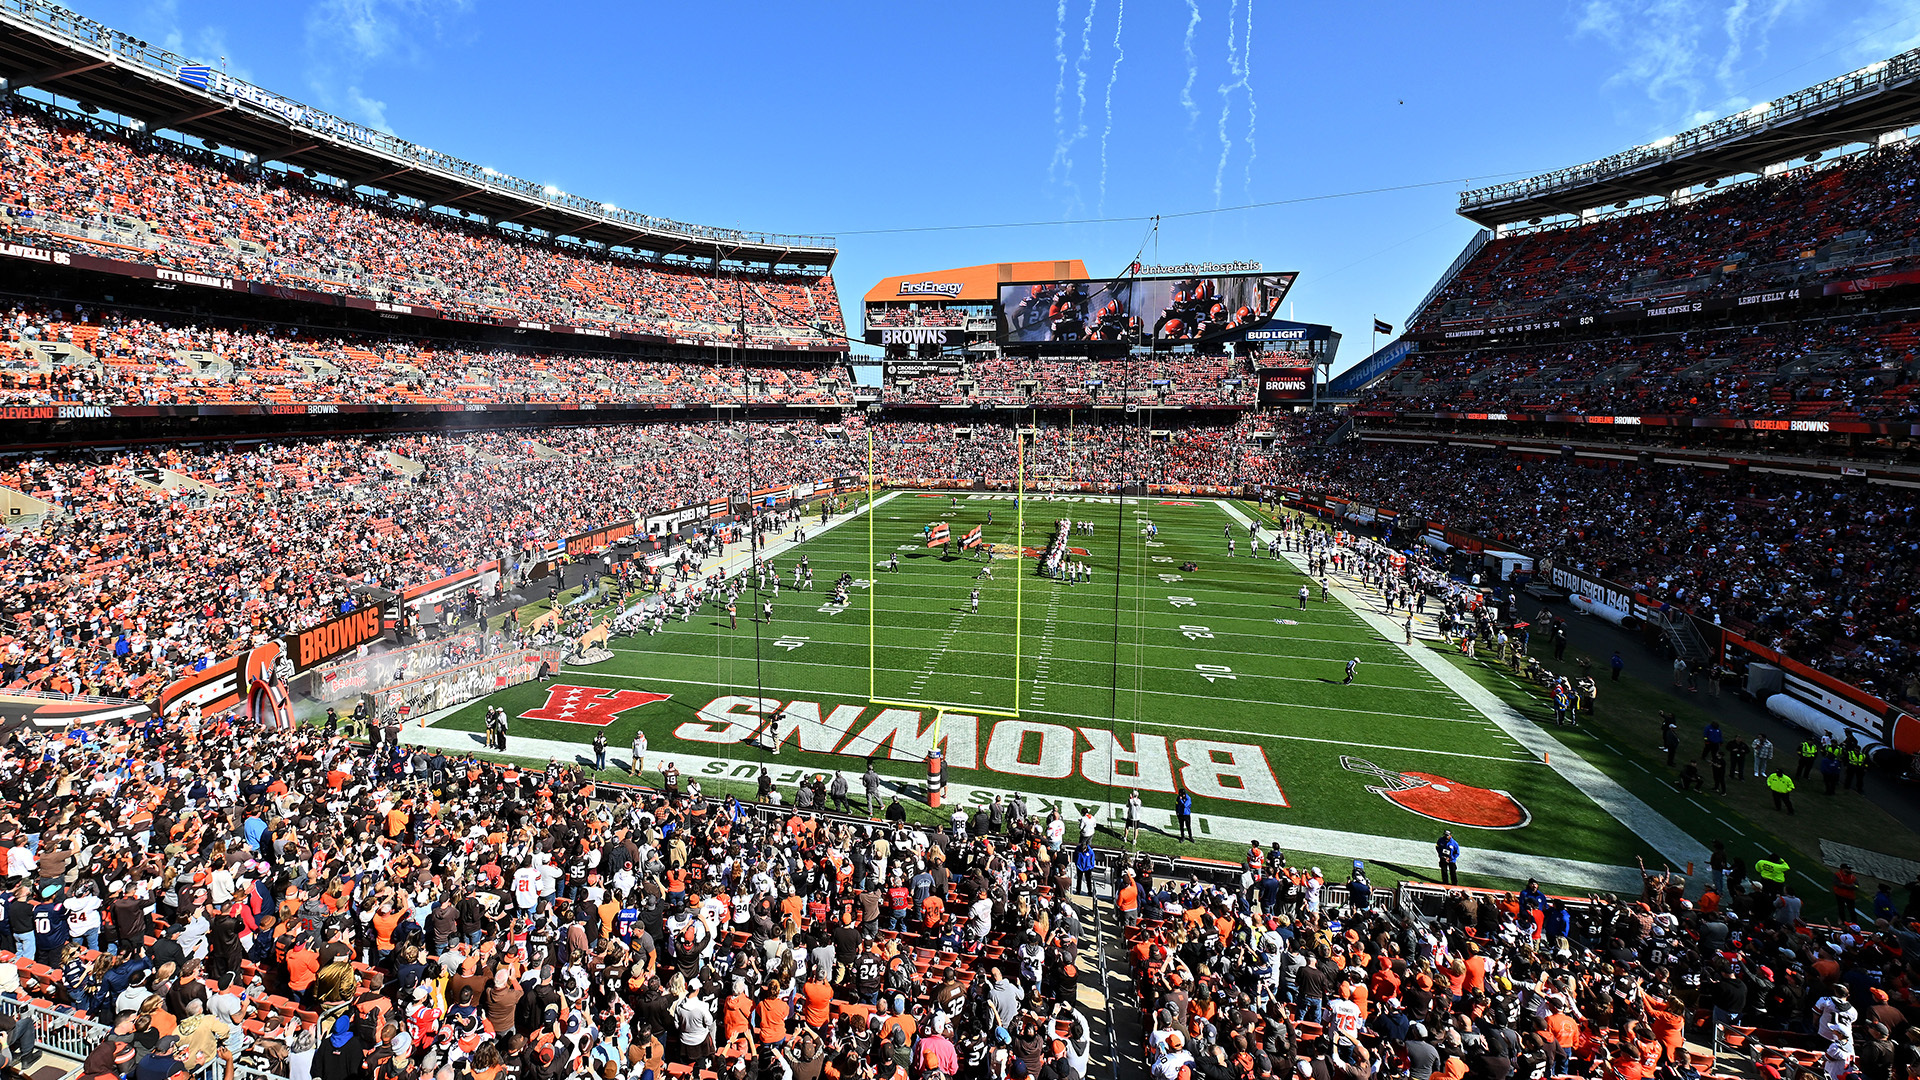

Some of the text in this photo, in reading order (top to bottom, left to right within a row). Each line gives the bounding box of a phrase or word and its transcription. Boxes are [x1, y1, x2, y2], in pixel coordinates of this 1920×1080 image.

[215, 73, 377, 146] FirstEnergy STADIUM
[53, 250, 71, 265] 86
[1140, 259, 1261, 276] University Hospitals
[222, 278, 234, 290] 14
[900, 281, 964, 295] FirstEnergy
[1738, 289, 1800, 306] LEROY KELLY 44
[1647, 307, 1667, 317] FRANK
[1692, 303, 1702, 312] 52
[882, 329, 947, 344] BROWNS
[1248, 330, 1305, 340] BUD LIGHT
[1349, 341, 1412, 386] PROGRESSIV
[1265, 381, 1307, 391] BROWNS
[0, 405, 112, 419] CLEVELAND BROWNS
[272, 404, 339, 415] CLEVELAND BROWNS
[465, 404, 488, 412] BROWNS
[1488, 413, 1508, 421] BROWNS
[1614, 416, 1641, 425] BROWNS
[1754, 420, 1830, 432] CLEVELAND BROWNS
[1553, 568, 1630, 615] ESTABLISHED 1946
[301, 606, 380, 666] BROWNS
[1179, 625, 1215, 639] 20
[773, 635, 811, 648] 10
[1195, 663, 1237, 680] 10
[407, 694, 420, 706] THE
[672, 695, 1291, 808] BROWNS
[701, 761, 760, 779] US
[302, 782, 314, 794] 19
[667, 776, 677, 786] 19
[570, 865, 586, 879] 95
[691, 868, 702, 880] 13
[518, 879, 529, 892] 21
[736, 903, 748, 913] 24
[892, 896, 905, 908] 35
[69, 911, 87, 923] 24
[301, 917, 314, 931] 21
[34, 917, 51, 934] 10
[859, 964, 878, 980] 24
[947, 995, 965, 1018] 32
[1336, 1013, 1355, 1031] 73
